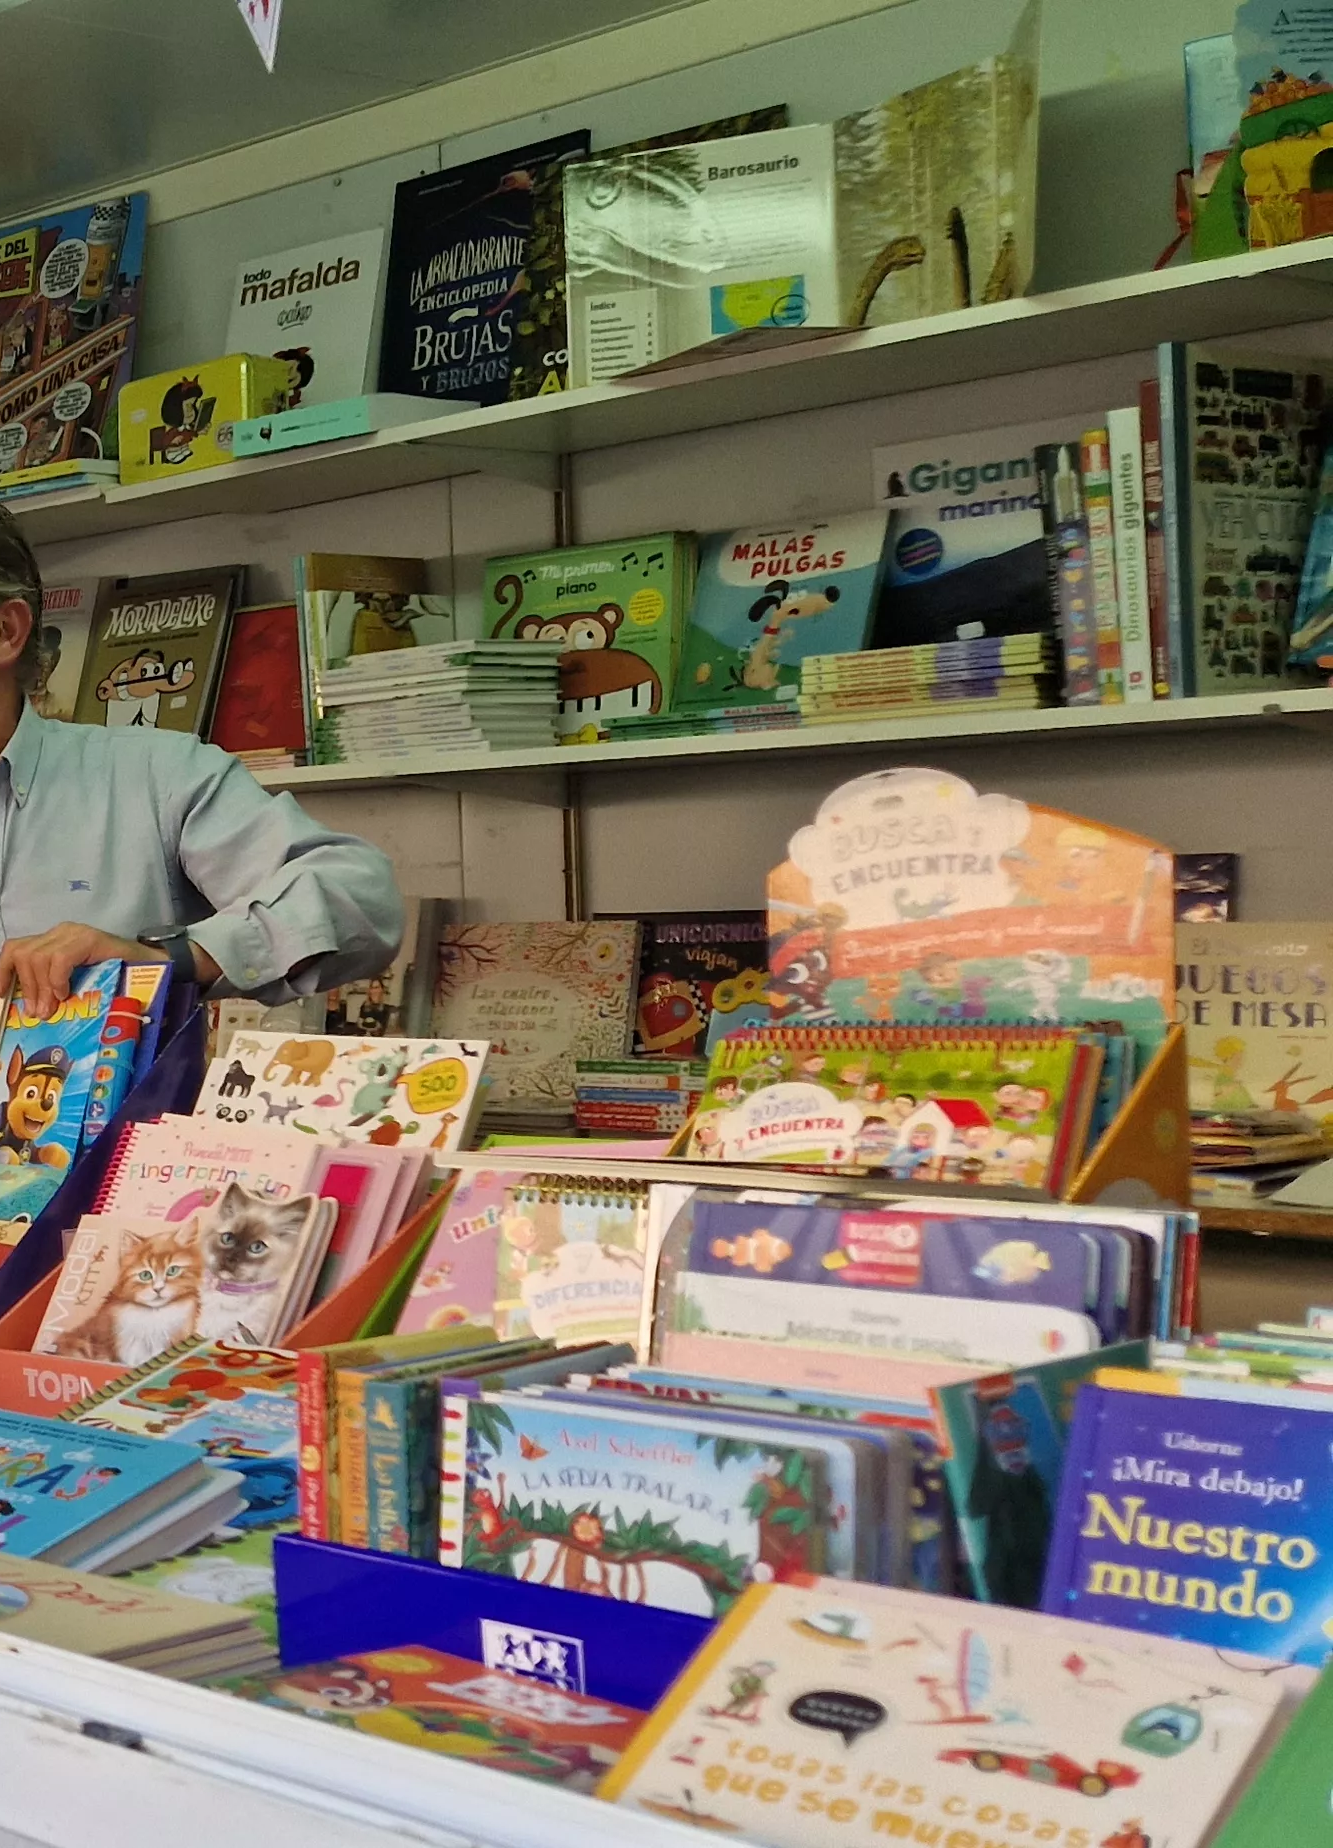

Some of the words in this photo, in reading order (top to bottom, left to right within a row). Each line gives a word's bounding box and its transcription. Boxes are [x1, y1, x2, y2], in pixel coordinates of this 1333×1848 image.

[708, 154, 800, 182] Barosaurio
[4, 238, 30, 259] DEL
[239, 257, 361, 307] mafalda
[243, 268, 272, 284] todo
[409, 270, 425, 306] LA
[424, 234, 529, 293] ABRACADABRANTE
[418, 276, 509, 314] ENCICLOPEDIA
[411, 309, 514, 372] BRUJAS
[41, 366, 76, 402] UNA
[77, 336, 122, 372] CASA
[436, 356, 511, 394] BRUJOS
[1121, 452, 1141, 530] gigantes
[732, 534, 816, 562] MALAS
[750, 550, 847, 580] PULGAS
[556, 580, 597, 600] piano
[1124, 532, 1142, 643] Dinosaurios
[833, 813, 959, 865] BUSCA
[832, 852, 1000, 896] ENCUENTRA
[685, 948, 738, 971] viajan
[471, 983, 497, 999] Las
[1232, 1000, 1328, 1027] MESA
[417, 1074, 457, 1096] 500
[747, 1117, 846, 1140] ENCUENTRA
[129, 1163, 249, 1184] Fingerprint
[255, 1174, 291, 1198] Fun
[559, 1427, 598, 1452] Axel
[1161, 1431, 1244, 1457] Usborne
[520, 1469, 552, 1491] LA
[1111, 1456, 1191, 1488] ¡Mira
[1198, 1467, 1306, 1507] debajo!
[1080, 1493, 1320, 1570] Nuestro
[1086, 1560, 1294, 1623] mundo
[701, 1763, 789, 1804] que
[796, 1789, 860, 1823] se
[727, 1738, 847, 1786] todas
[860, 1771, 927, 1805] las
[940, 1795, 1092, 1848] cosas
